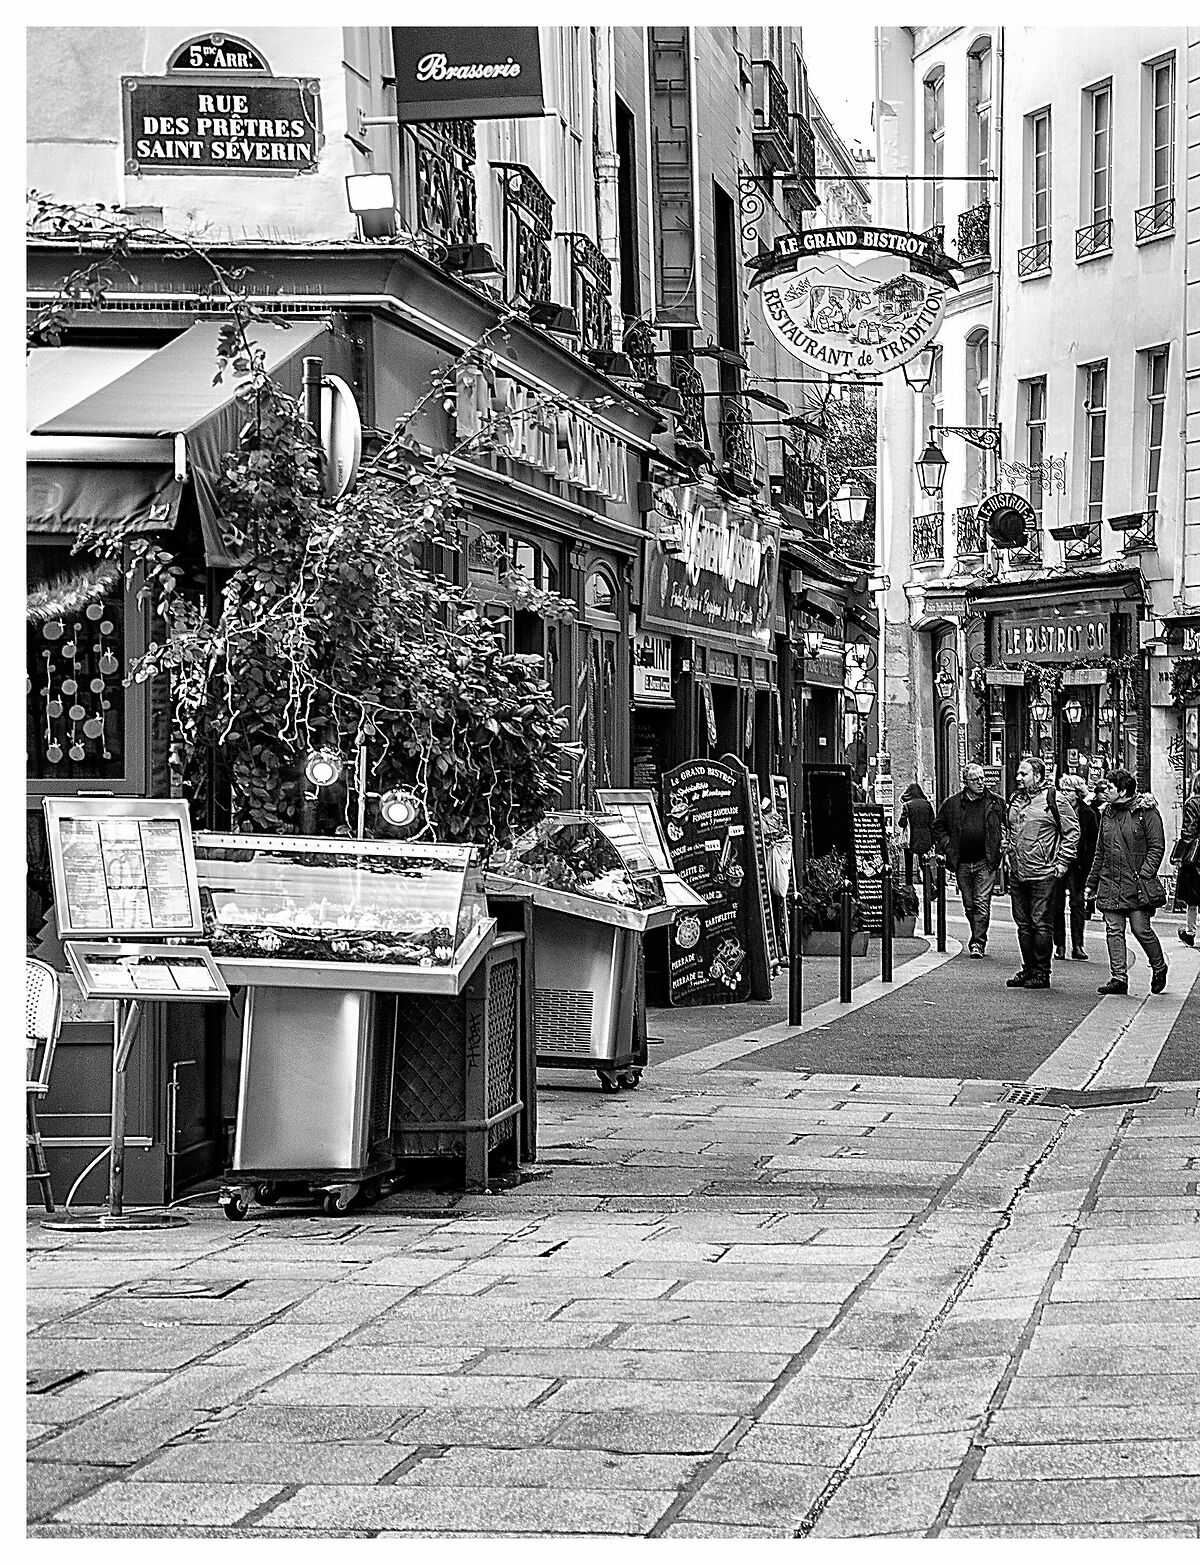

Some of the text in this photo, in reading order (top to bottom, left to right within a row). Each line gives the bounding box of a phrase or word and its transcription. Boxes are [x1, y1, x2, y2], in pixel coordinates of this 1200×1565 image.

[416, 53, 521, 81] Brasserie
[198, 94, 249, 113] RUE
[143, 114, 305, 138] DES PRÊTRES
[136, 136, 311, 162] SAINT SÉVERIN
[778, 230, 928, 257] LE GRAND BISTROT
[764, 286, 945, 367] RESTAURANT de TRADITION
[1006, 622, 1104, 654] LE BISTROT 30
[680, 766, 706, 780] GRAND
[707, 767, 737, 786] BISTROT
